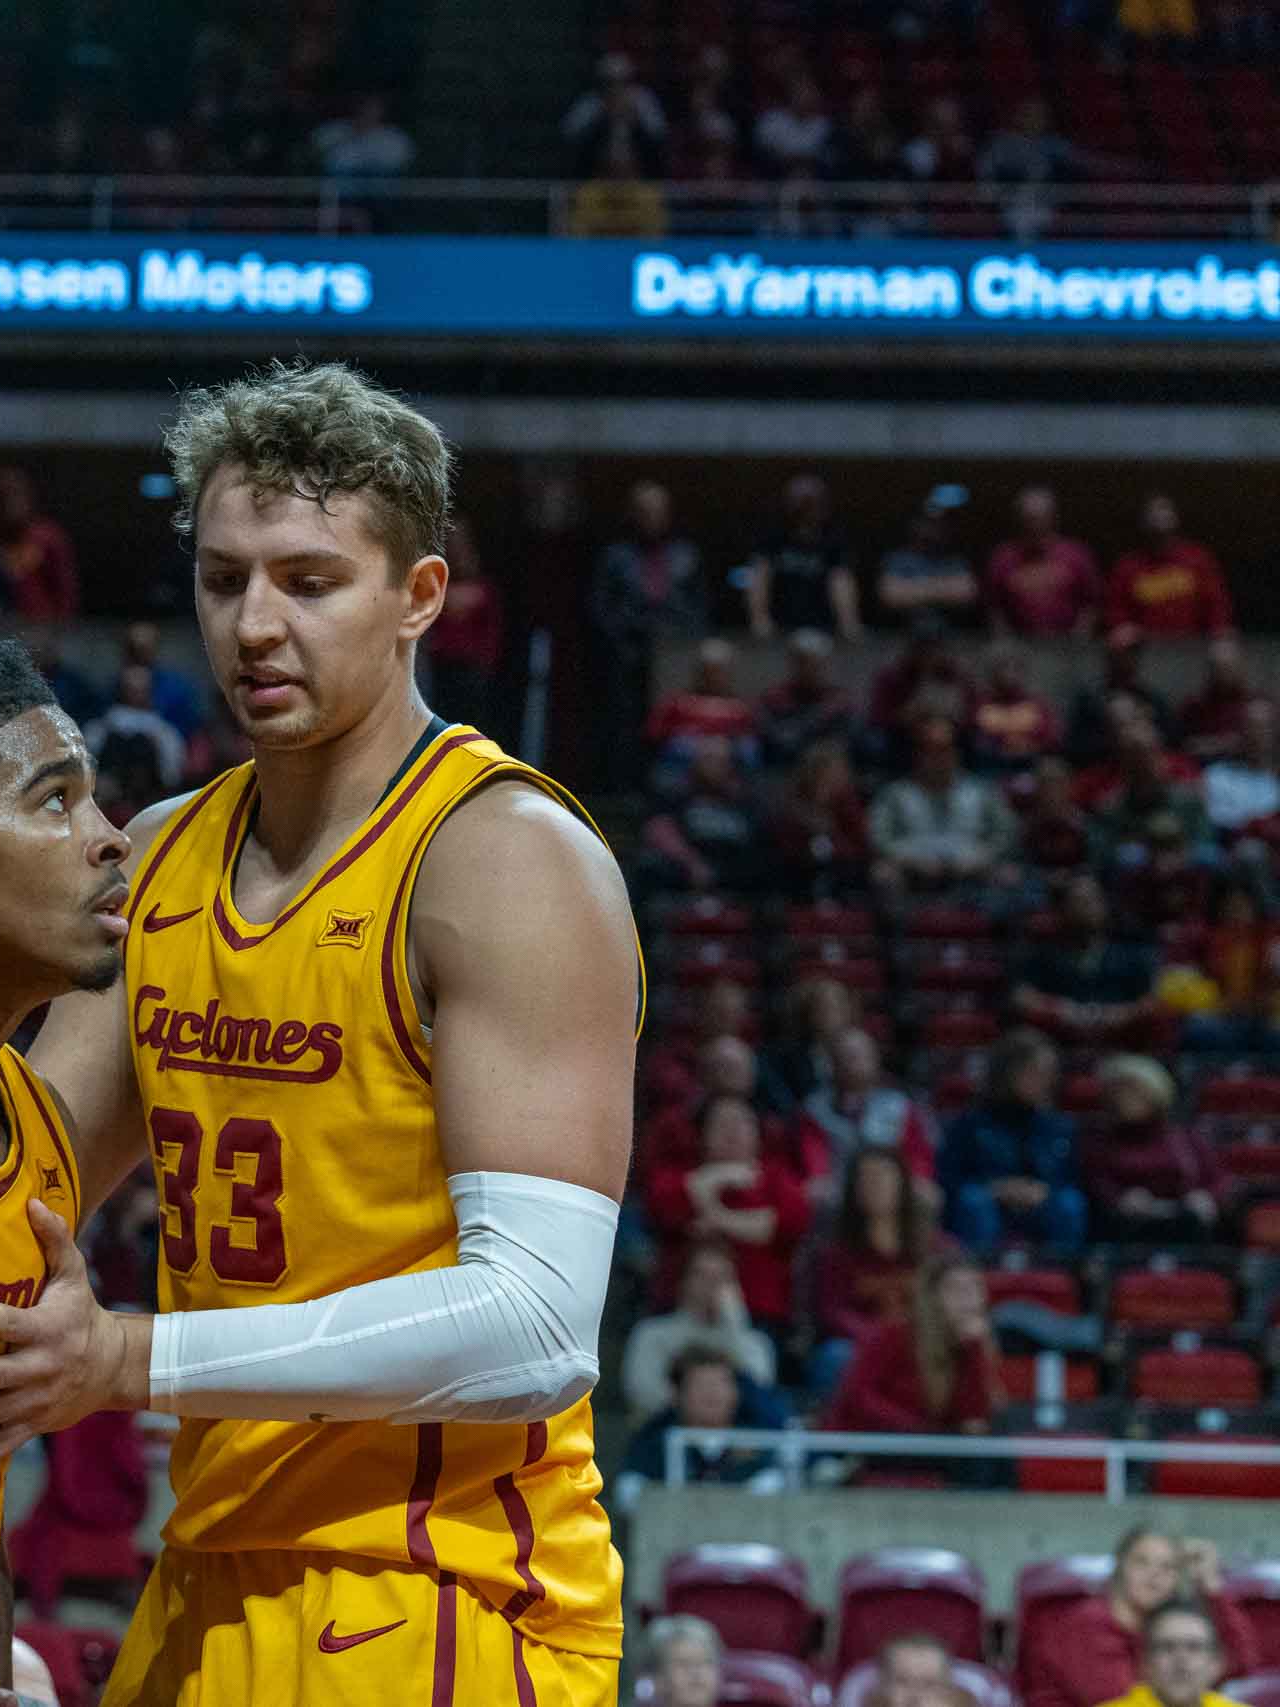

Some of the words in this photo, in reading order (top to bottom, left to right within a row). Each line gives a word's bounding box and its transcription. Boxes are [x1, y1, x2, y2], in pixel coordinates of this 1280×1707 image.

[140, 251, 370, 312] Motors
[634, 255, 958, 315] DeYarman
[971, 257, 1280, 318] Chevrolet
[134, 984, 343, 1084] Cyclones
[148, 1104, 289, 1286] 33
